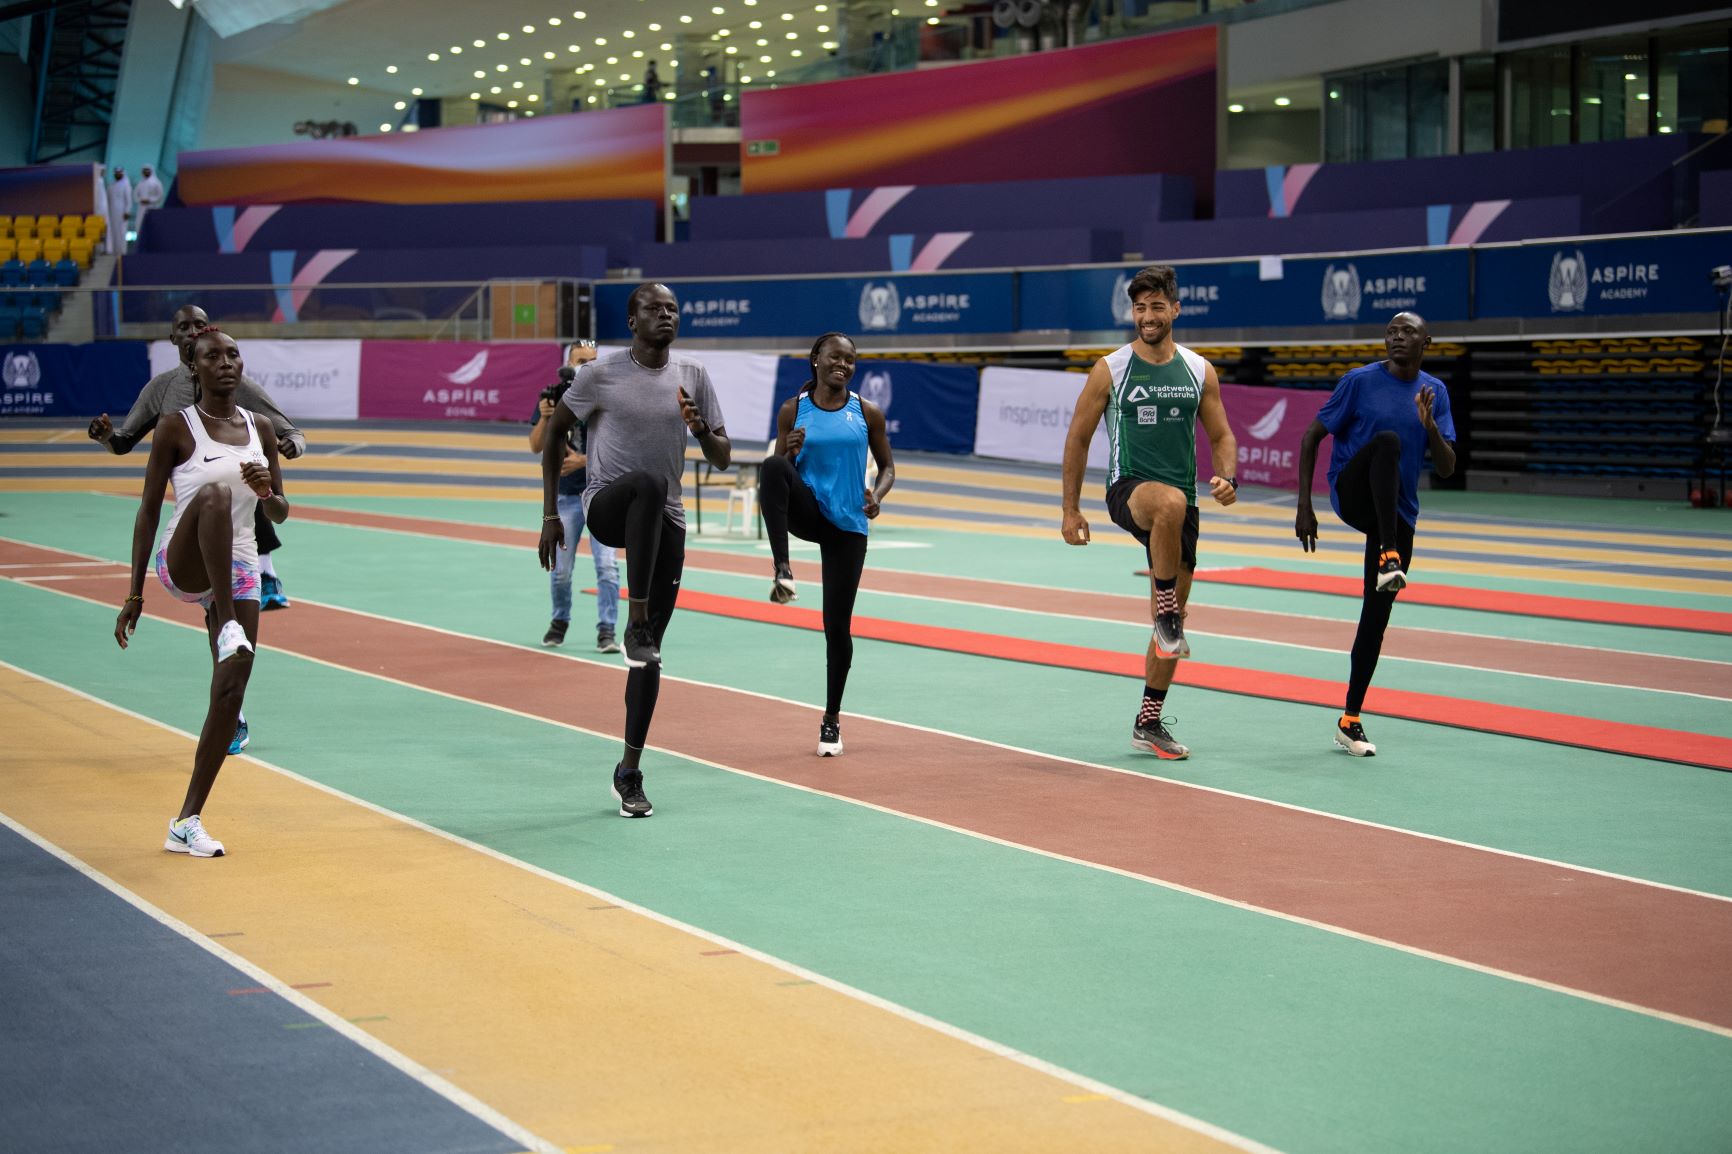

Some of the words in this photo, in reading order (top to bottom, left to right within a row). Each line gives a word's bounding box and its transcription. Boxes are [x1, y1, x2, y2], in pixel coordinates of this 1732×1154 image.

[1591, 262, 1660, 284] ASPIRE
[1178, 284, 1220, 303] PIRE
[1363, 274, 1427, 295] ASPIRE
[1600, 287, 1648, 300] ACADEMY
[681, 298, 752, 316] ASPIRE
[902, 293, 971, 311] ASPIRE
[0, 391, 54, 405] SPIRE
[422, 386, 500, 406] ASPIRE
[1157, 391, 1195, 399] Karlsruhe
[999, 400, 1060, 427] inspired
[1237, 446, 1293, 468] SPIRE
